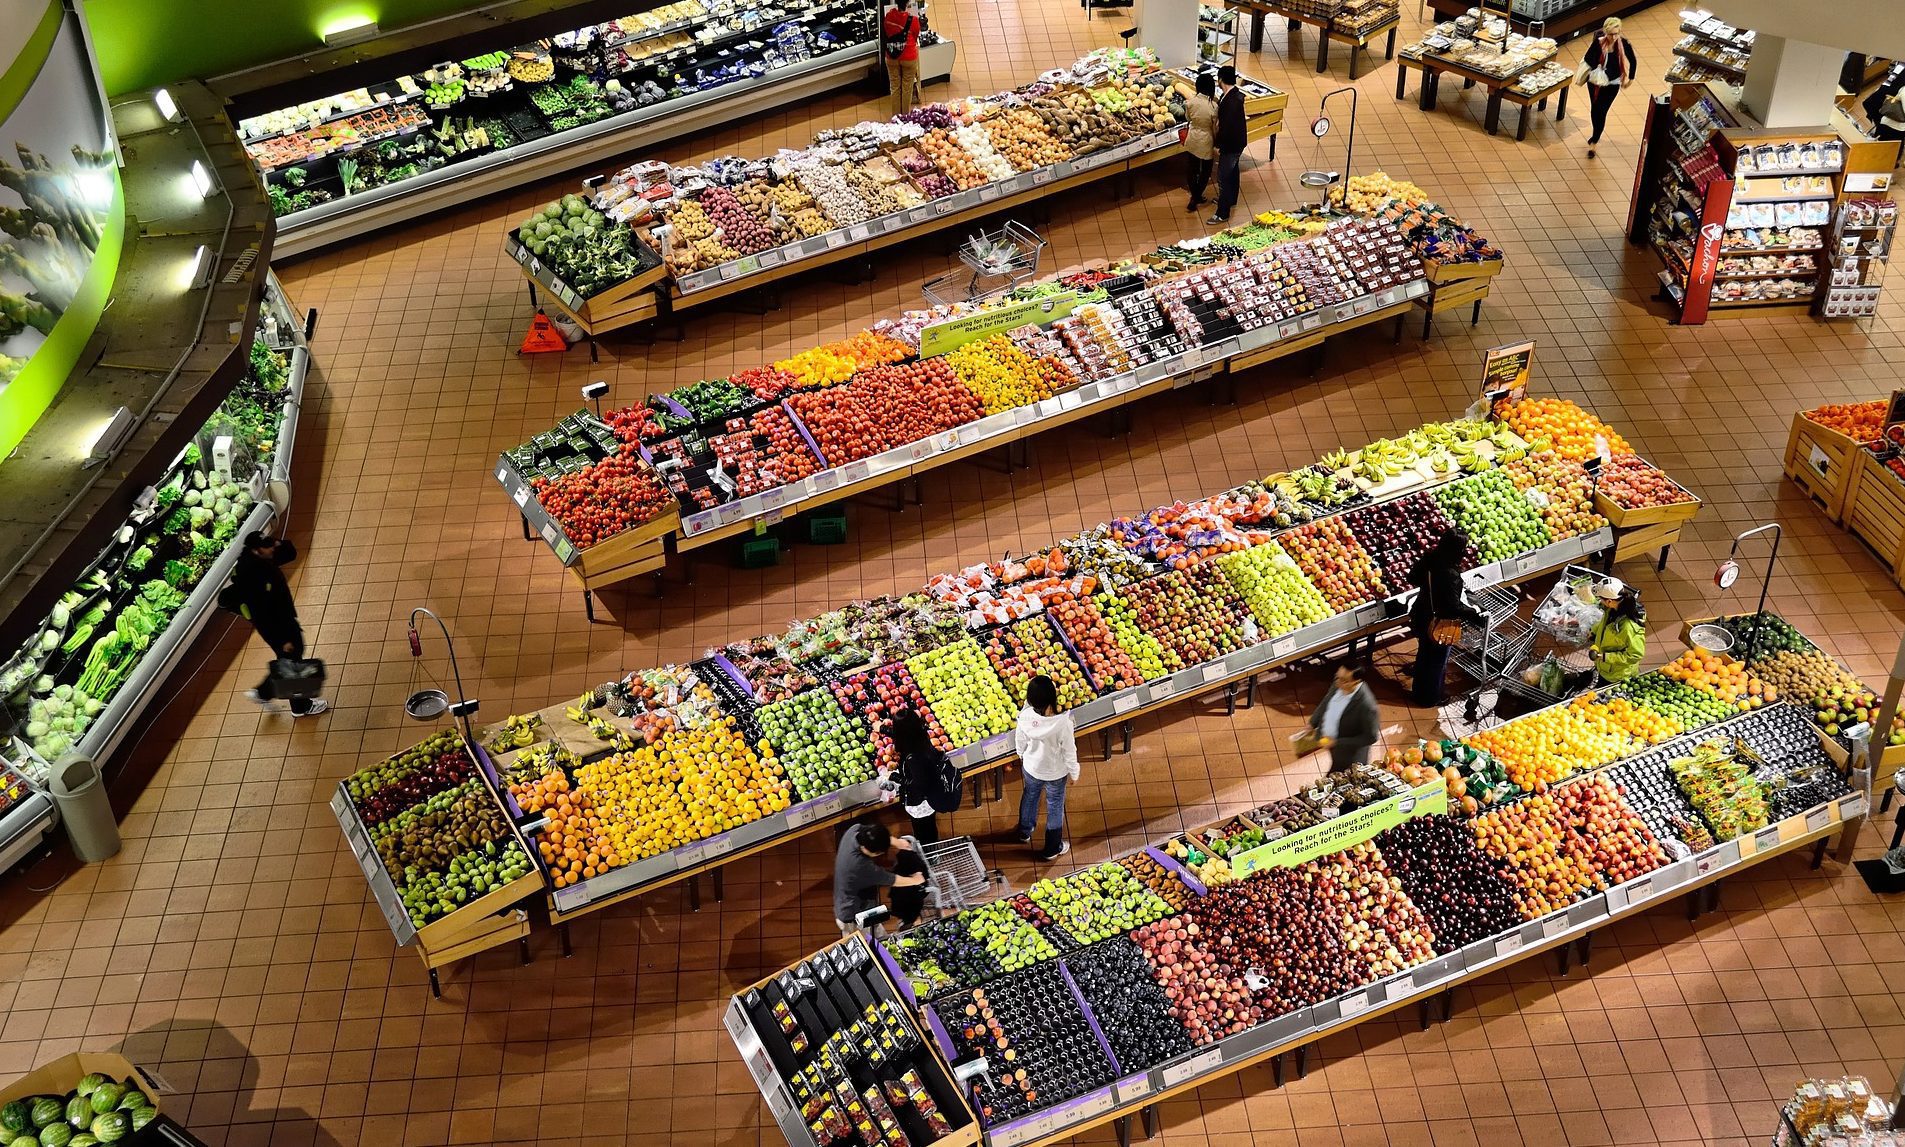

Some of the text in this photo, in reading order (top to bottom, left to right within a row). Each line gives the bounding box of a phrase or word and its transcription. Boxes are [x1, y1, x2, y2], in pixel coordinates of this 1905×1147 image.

[1700, 223, 1723, 284] Vachon
[949, 320, 972, 331] Looking
[974, 316, 982, 325] for
[983, 311, 1012, 322] nutritious
[1013, 303, 1039, 315] choices?
[964, 314, 1023, 333] Reach for the Stars!
[1272, 838, 1304, 854] Looking
[1305, 833, 1317, 842] for
[1319, 817, 1358, 837] nutritious
[1360, 803, 1394, 822] choices?
[1294, 820, 1373, 854] Reach for the Stars!
